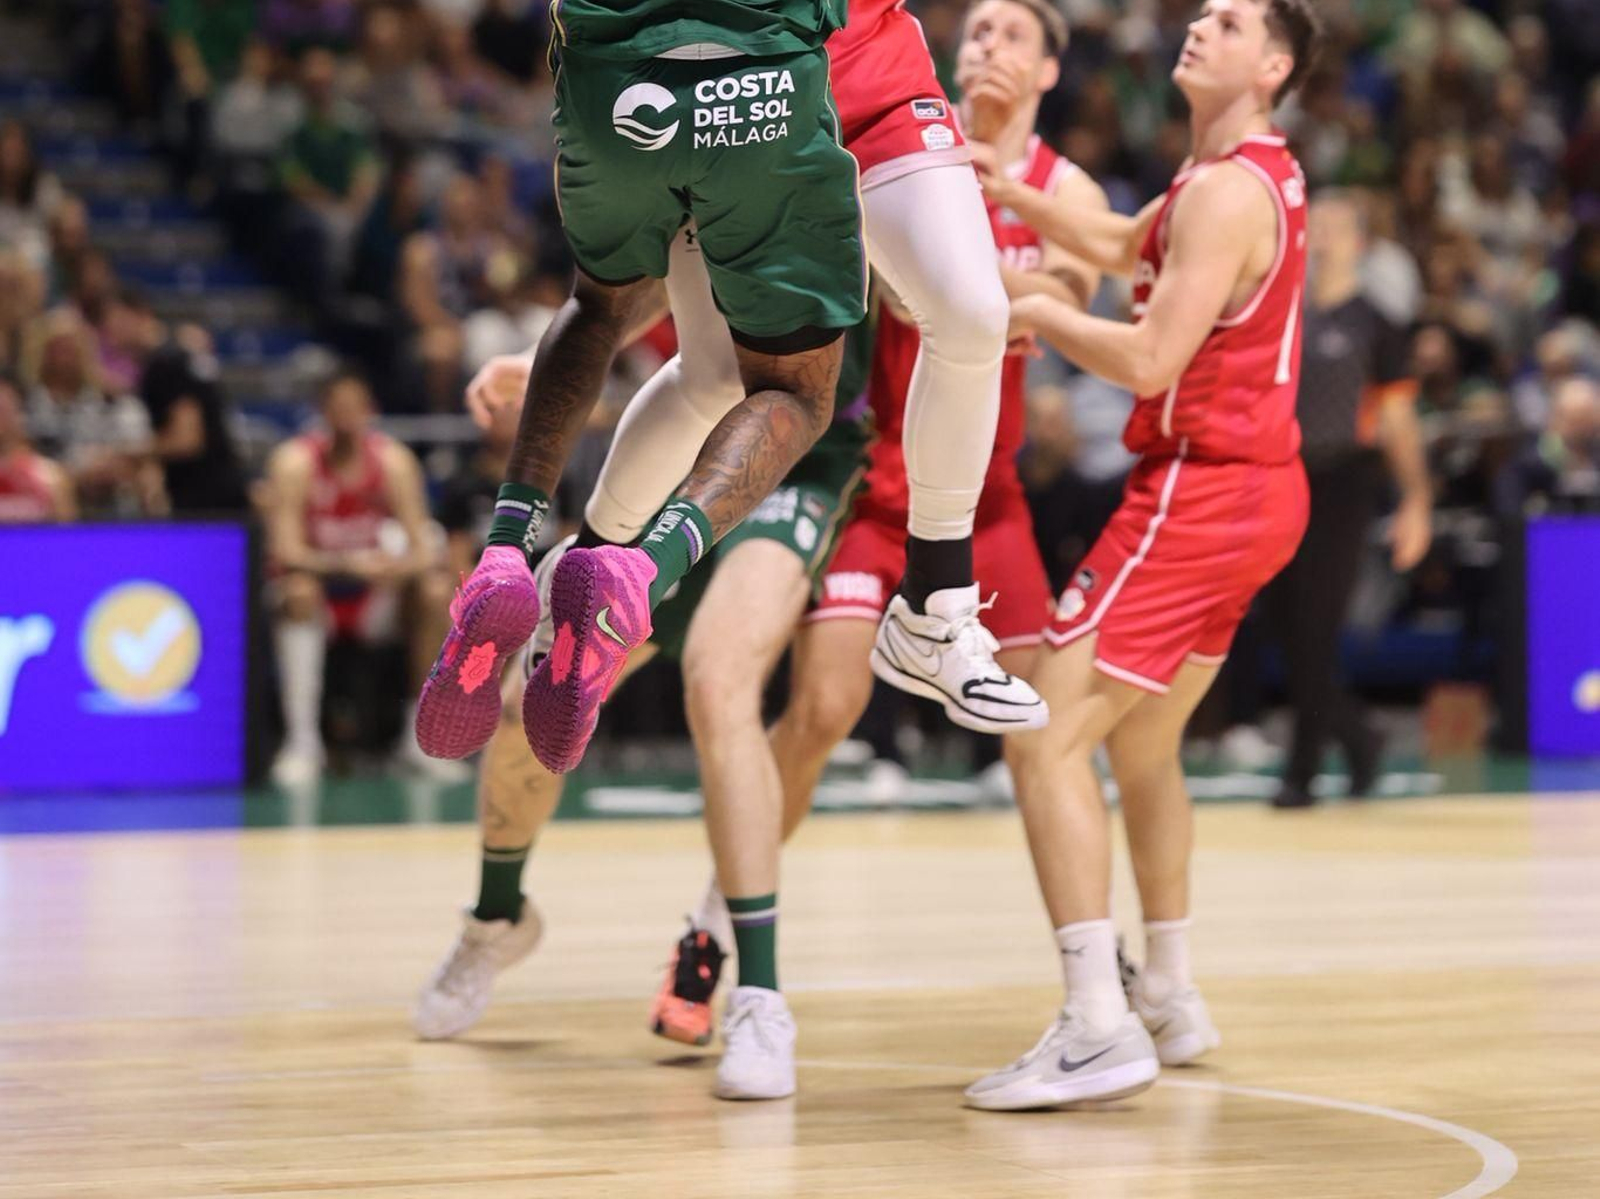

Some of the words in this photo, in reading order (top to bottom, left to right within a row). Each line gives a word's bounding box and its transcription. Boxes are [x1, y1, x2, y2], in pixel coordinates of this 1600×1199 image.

[694, 70, 796, 103] COSTA
[694, 105, 744, 128] DEL
[749, 98, 793, 121] SOL
[693, 122, 788, 150] MÁLAGA
